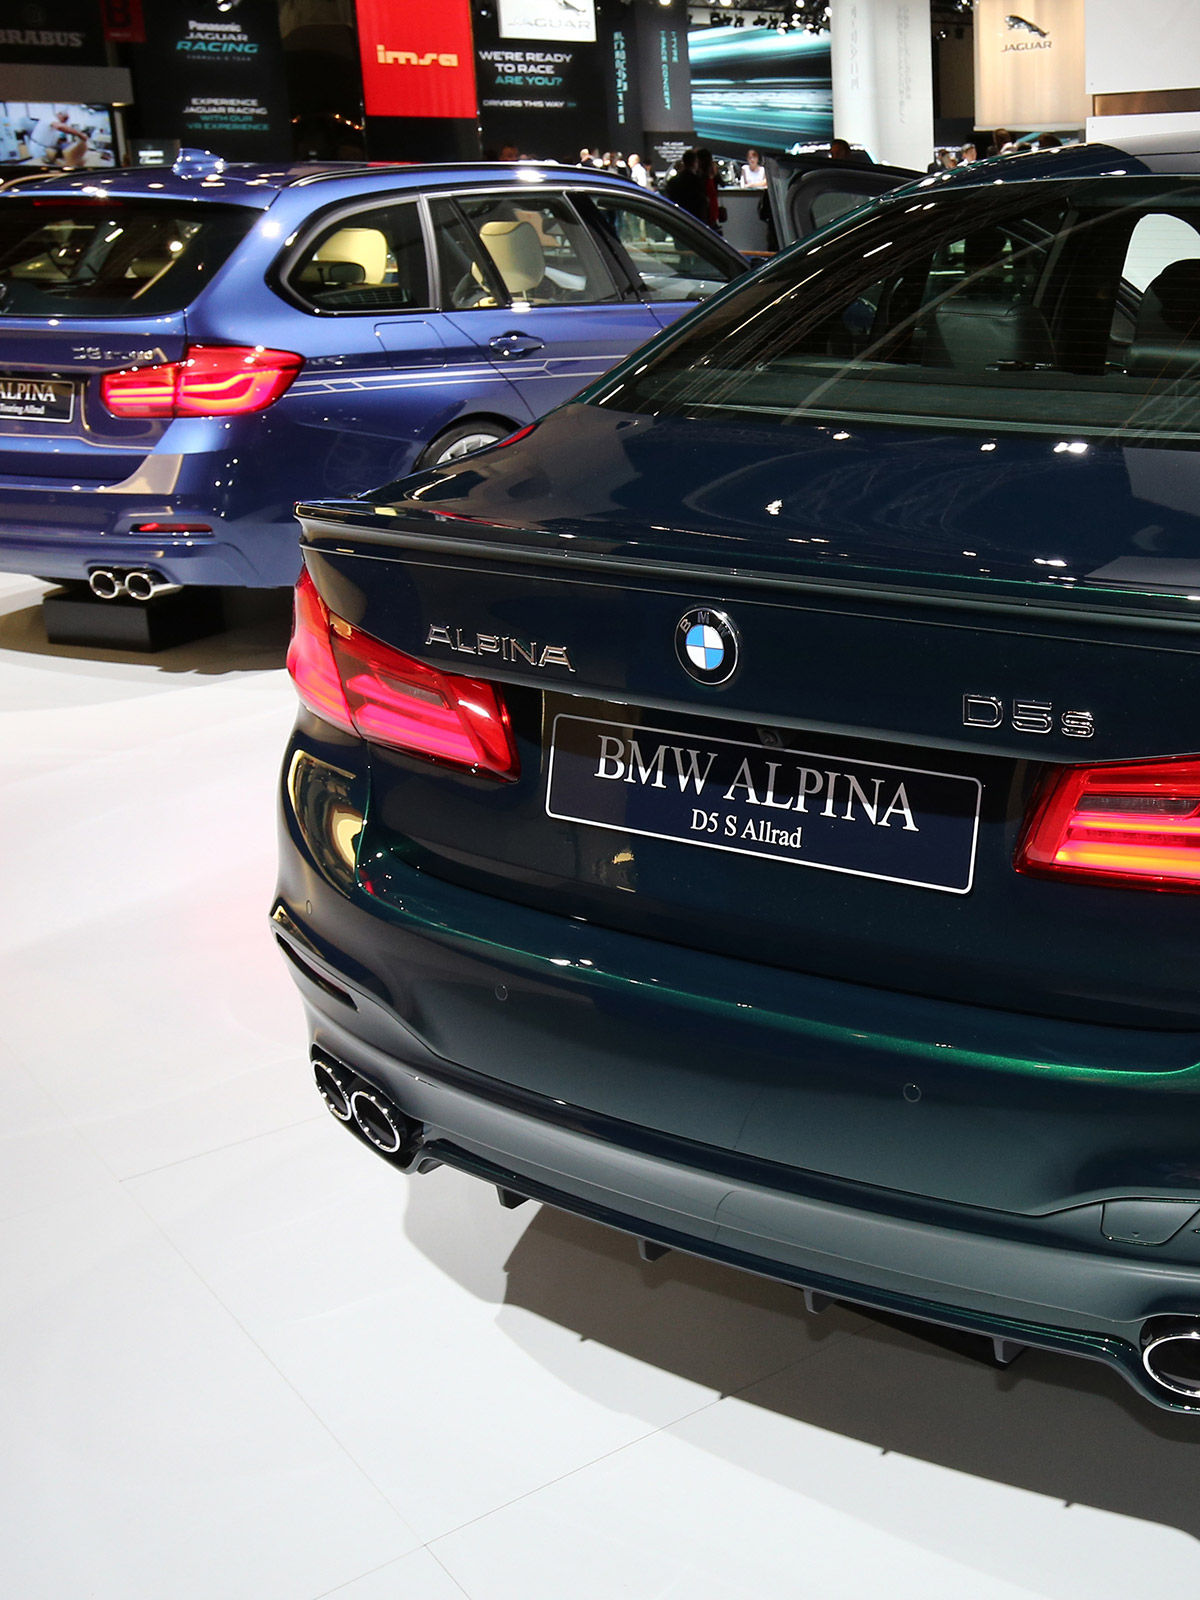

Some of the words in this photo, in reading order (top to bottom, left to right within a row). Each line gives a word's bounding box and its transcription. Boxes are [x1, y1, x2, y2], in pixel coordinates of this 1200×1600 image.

[506, 18, 591, 29] JAGUAR
[185, 32, 249, 41] JAGUAR
[176, 41, 259, 53] RACING
[1001, 40, 1053, 53] JAGUAR
[376, 44, 459, 67] imsa
[479, 50, 524, 61] WE'RE
[525, 52, 573, 63] READY
[495, 63, 516, 73] TO
[517, 64, 555, 74] RACE
[495, 76, 524, 85] ARE
[525, 77, 563, 86] YOU?
[424, 623, 577, 673] ALPINA
[594, 734, 718, 796] BMW
[722, 756, 920, 832] ALPINA
[690, 808, 719, 834] D5
[724, 815, 738, 838] S
[740, 823, 803, 849] Allrad
